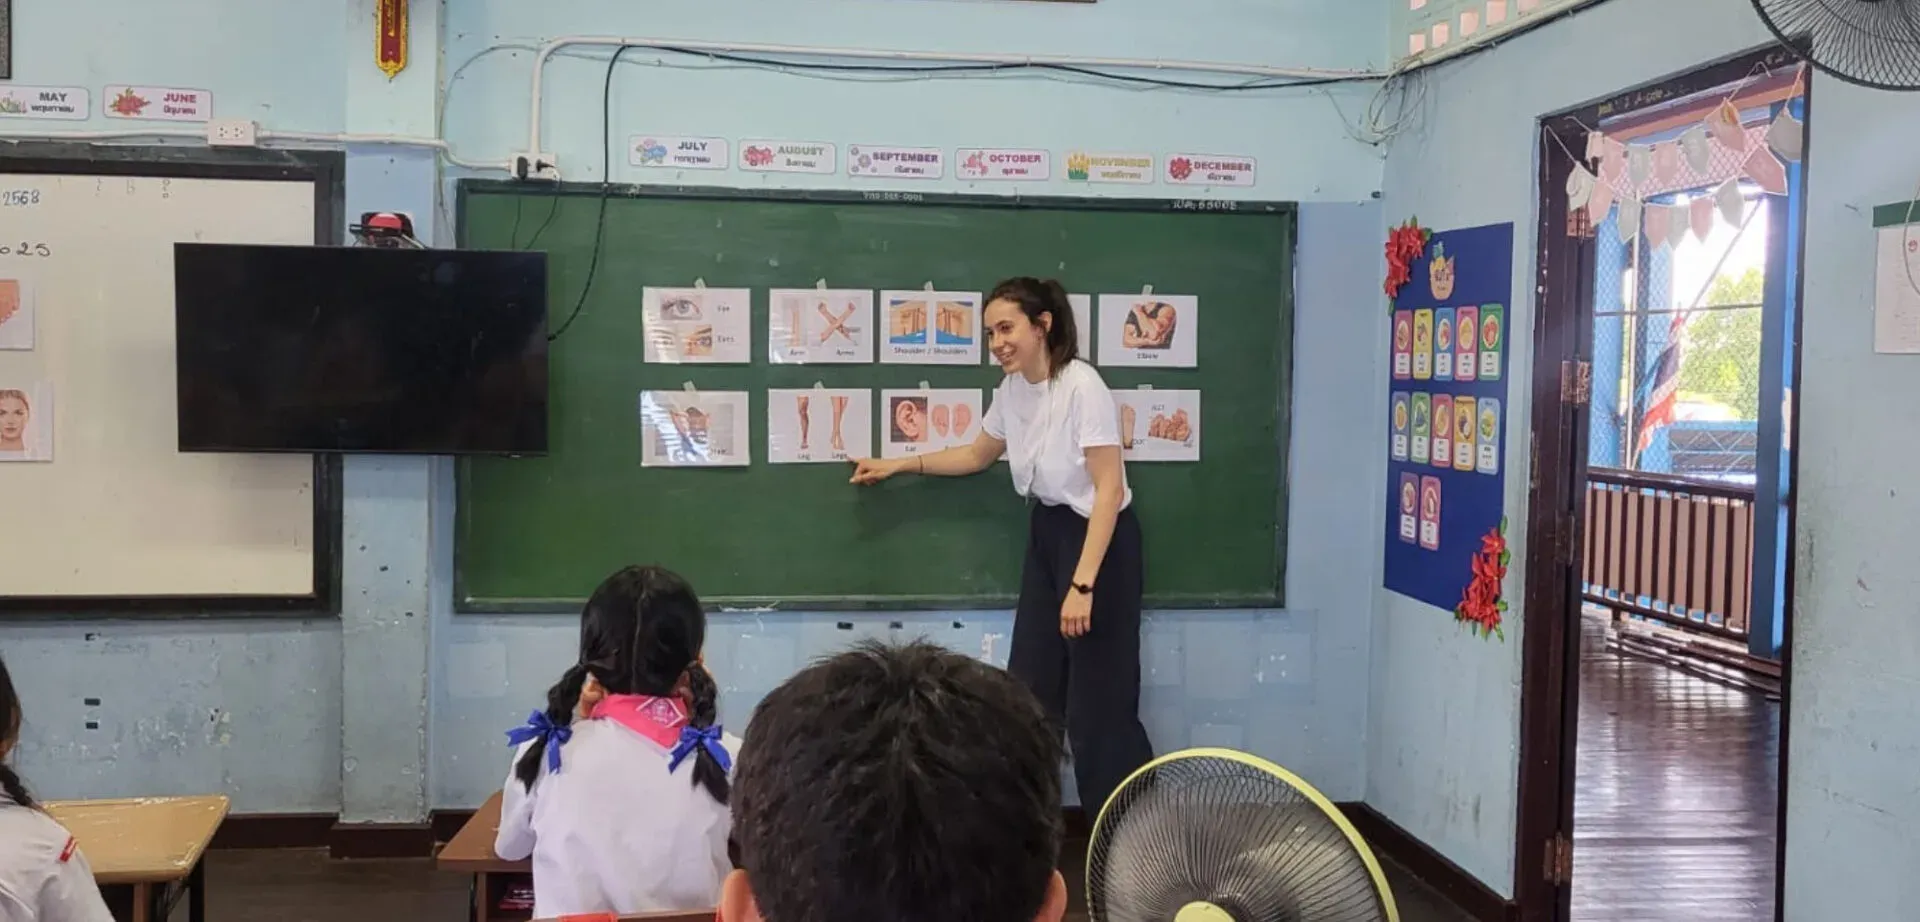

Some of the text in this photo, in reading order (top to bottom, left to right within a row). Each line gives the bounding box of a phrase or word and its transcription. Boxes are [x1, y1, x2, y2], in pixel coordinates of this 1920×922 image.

[39, 92, 67, 102] MAY
[163, 93, 197, 104] JUNE
[678, 141, 708, 151] JULY
[777, 146, 824, 156] AUGUST
[873, 152, 938, 163] SEPTEMBER
[989, 154, 1041, 163] OCTOBER
[1090, 157, 1150, 168] NOVEMBER
[1194, 161, 1252, 171] DECEMBER
[3, 189, 40, 206] 2568
[934, 347, 968, 355] Shoulders
